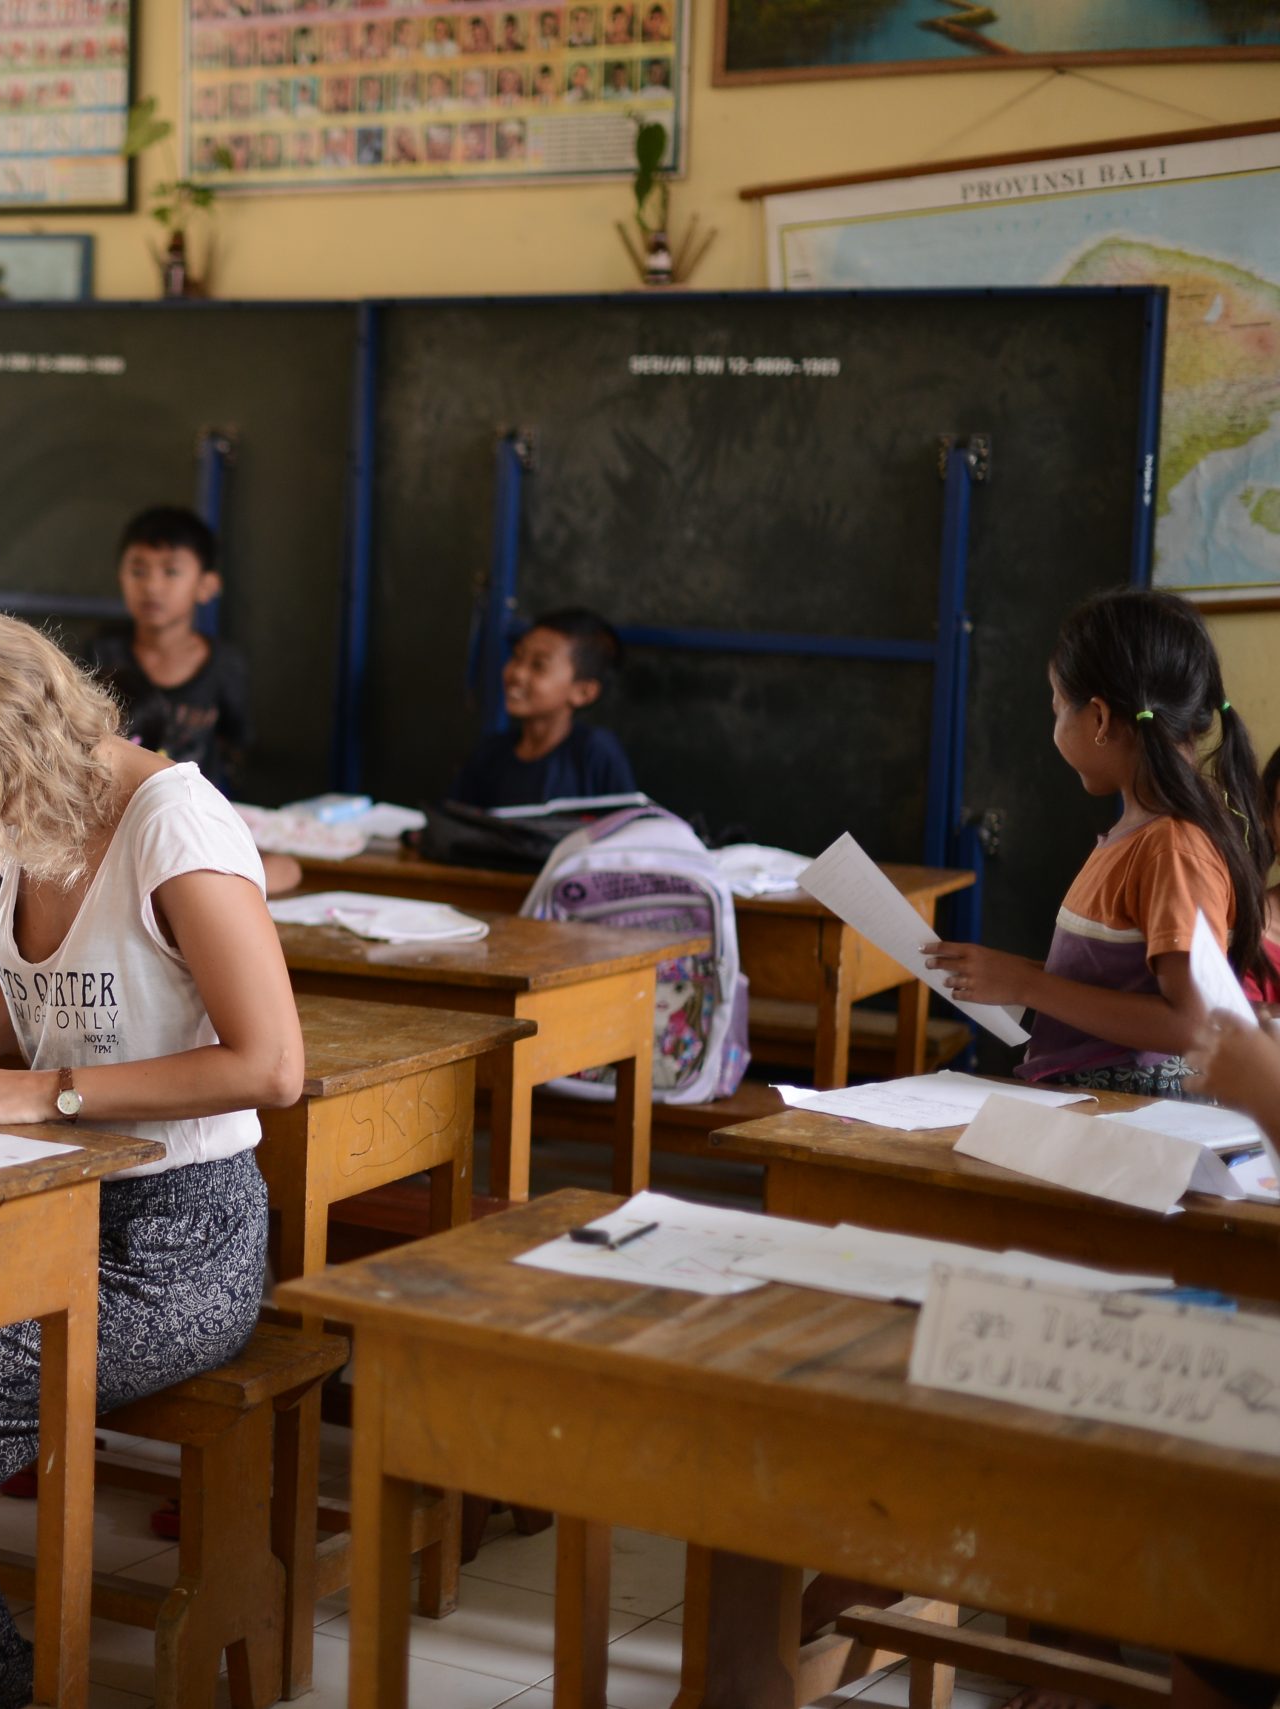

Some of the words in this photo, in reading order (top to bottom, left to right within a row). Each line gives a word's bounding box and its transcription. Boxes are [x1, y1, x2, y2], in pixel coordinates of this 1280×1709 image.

[960, 167, 1086, 203] PROVINSI
[1098, 157, 1168, 184] BALI
[56, 1010, 119, 1030] ONLY
[84, 1035, 103, 1044] NOV
[94, 1045, 112, 1054] 7PM
